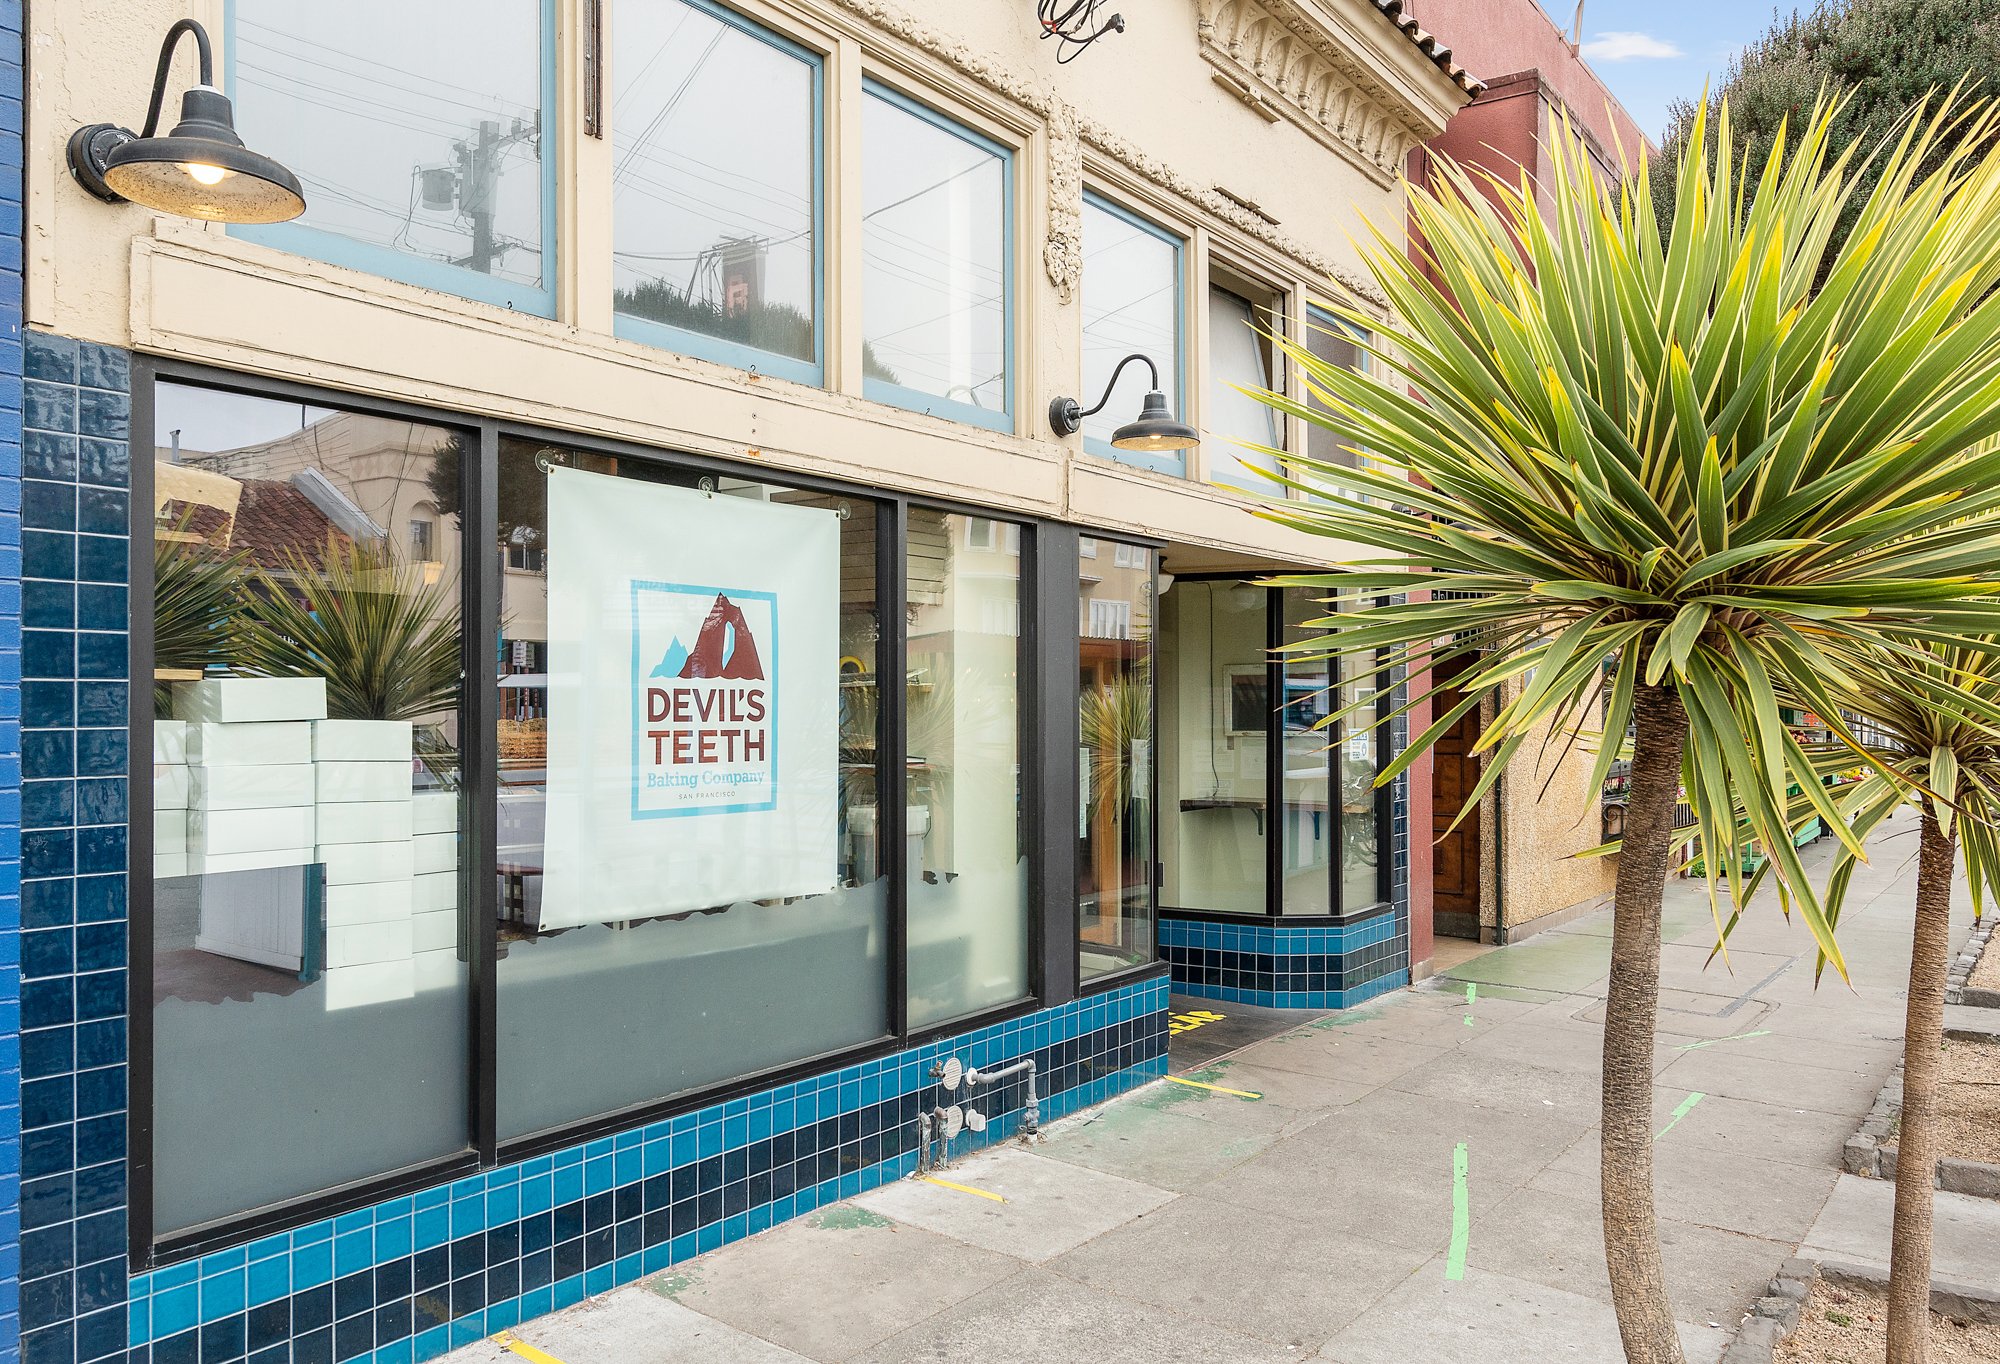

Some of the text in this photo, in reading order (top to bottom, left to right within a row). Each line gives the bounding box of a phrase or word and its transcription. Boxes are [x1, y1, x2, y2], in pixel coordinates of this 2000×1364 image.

[647, 687, 766, 723] DEVIL'S
[647, 729, 765, 765] TEETH
[647, 770, 765, 789] Baking Company
[696, 791, 736, 799] FRANCISCO
